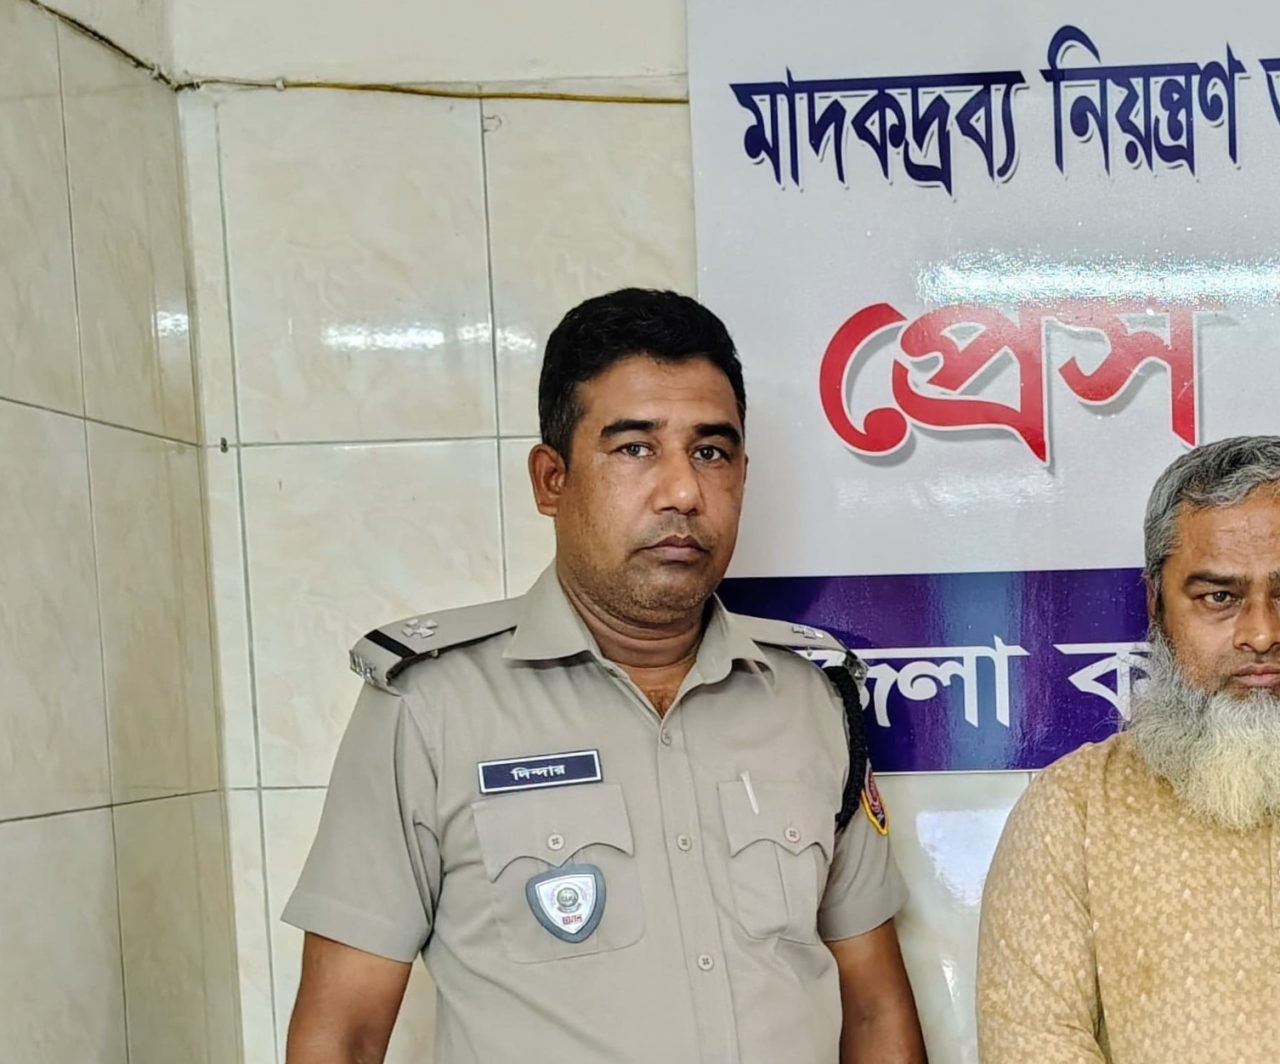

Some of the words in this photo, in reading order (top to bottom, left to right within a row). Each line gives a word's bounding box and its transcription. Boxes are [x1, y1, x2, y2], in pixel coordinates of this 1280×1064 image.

[729, 67, 1027, 195] মাদকদ্রব্য
[1039, 24, 1247, 175] নিয়ন্ত্রণ
[819, 301, 1220, 463] প্রেস
